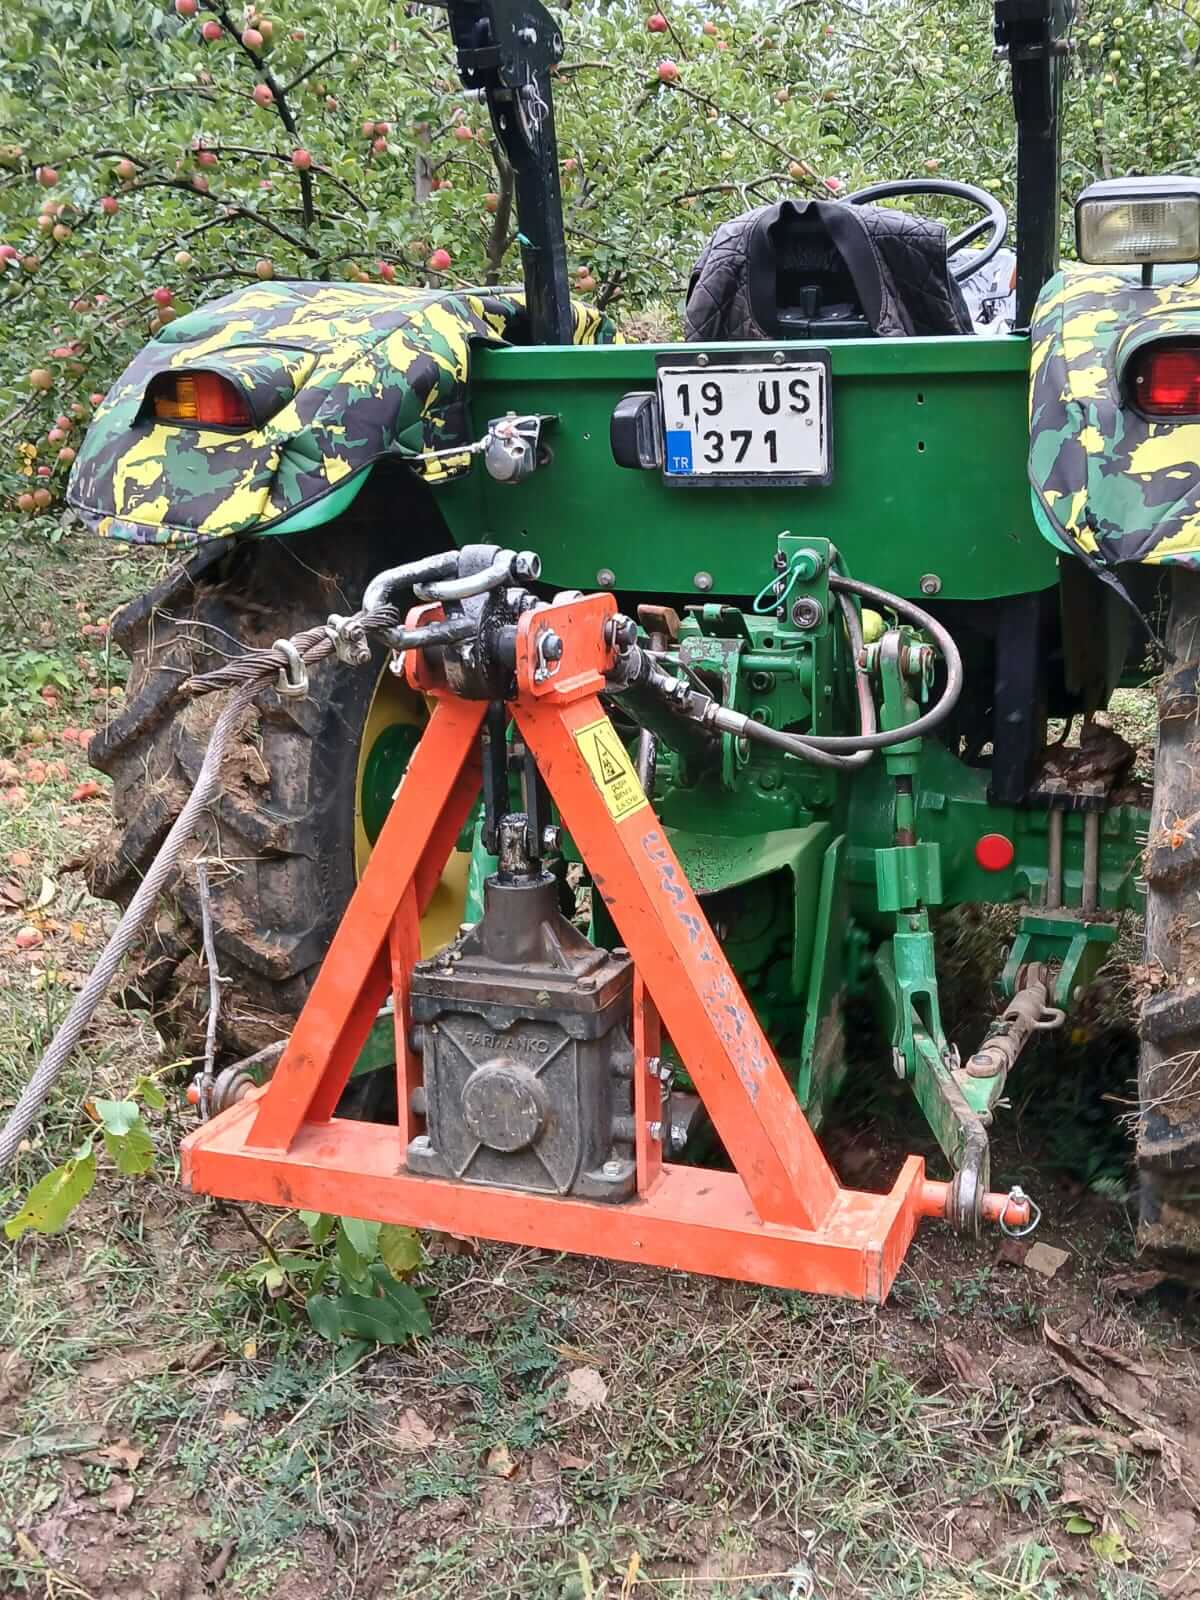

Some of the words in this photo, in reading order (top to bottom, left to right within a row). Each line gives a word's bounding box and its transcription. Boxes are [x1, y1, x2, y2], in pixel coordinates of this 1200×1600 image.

[677, 382, 723, 416] 19
[758, 379, 811, 415] US
[672, 457, 689, 469] TR
[703, 430, 778, 463] 371
